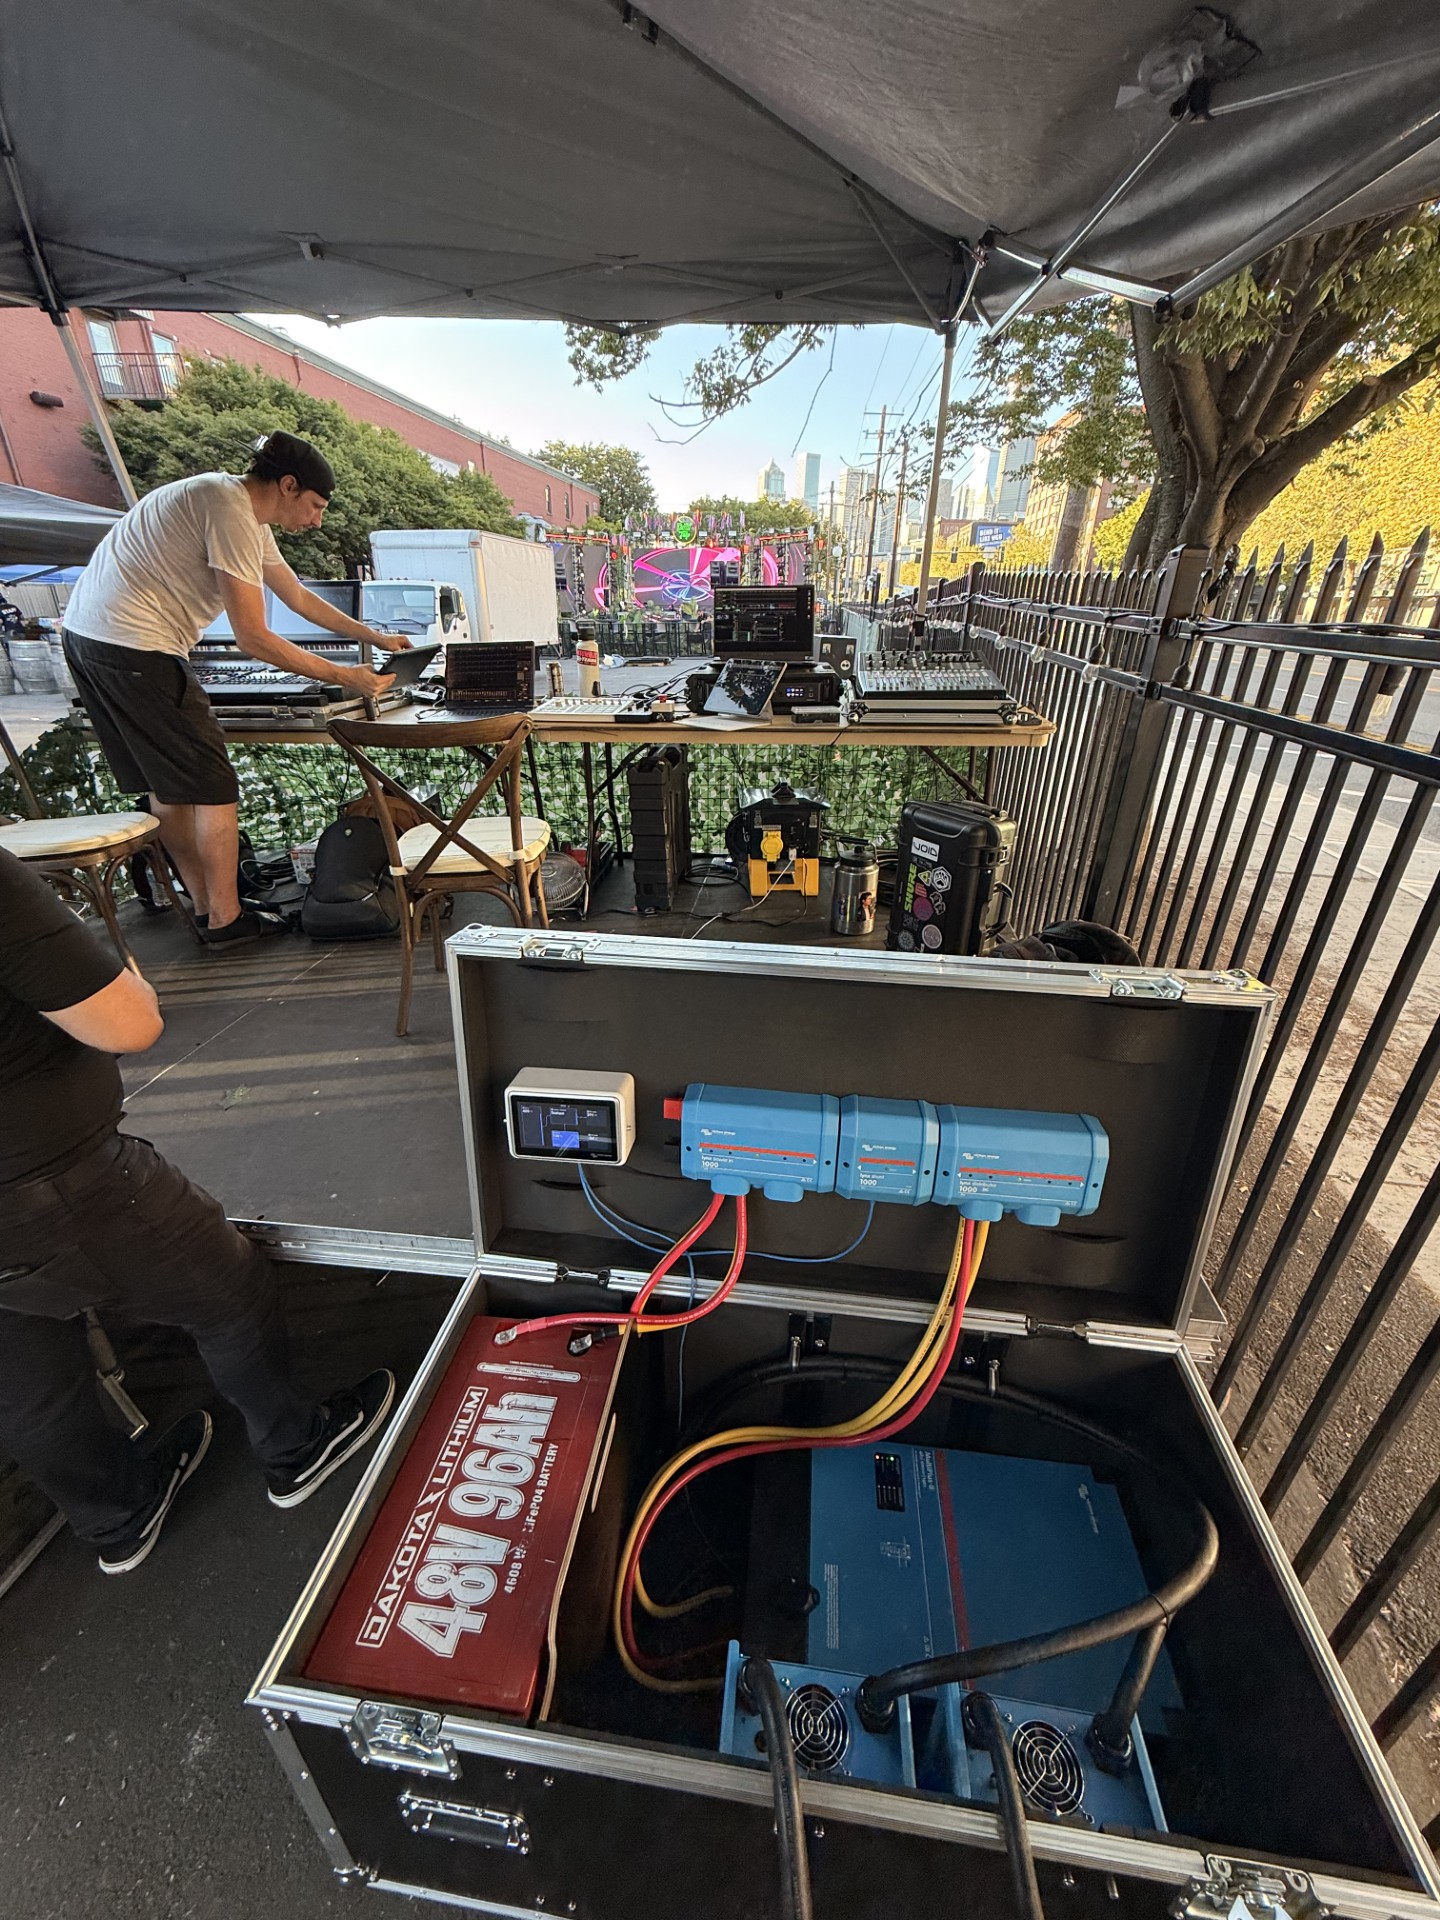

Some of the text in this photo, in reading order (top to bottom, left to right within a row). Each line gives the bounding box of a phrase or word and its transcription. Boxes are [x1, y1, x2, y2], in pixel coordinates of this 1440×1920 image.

[904, 863, 918, 913] SHURE
[959, 1185, 978, 1193] 1000
[363, 1391, 484, 1640] DAKOTA LITHIUM
[448, 1391, 558, 1521] 96Ah
[504, 1562, 523, 1594] 4608
[537, 1443, 559, 1487] BATTERY
[397, 1522, 512, 1658] 48V
